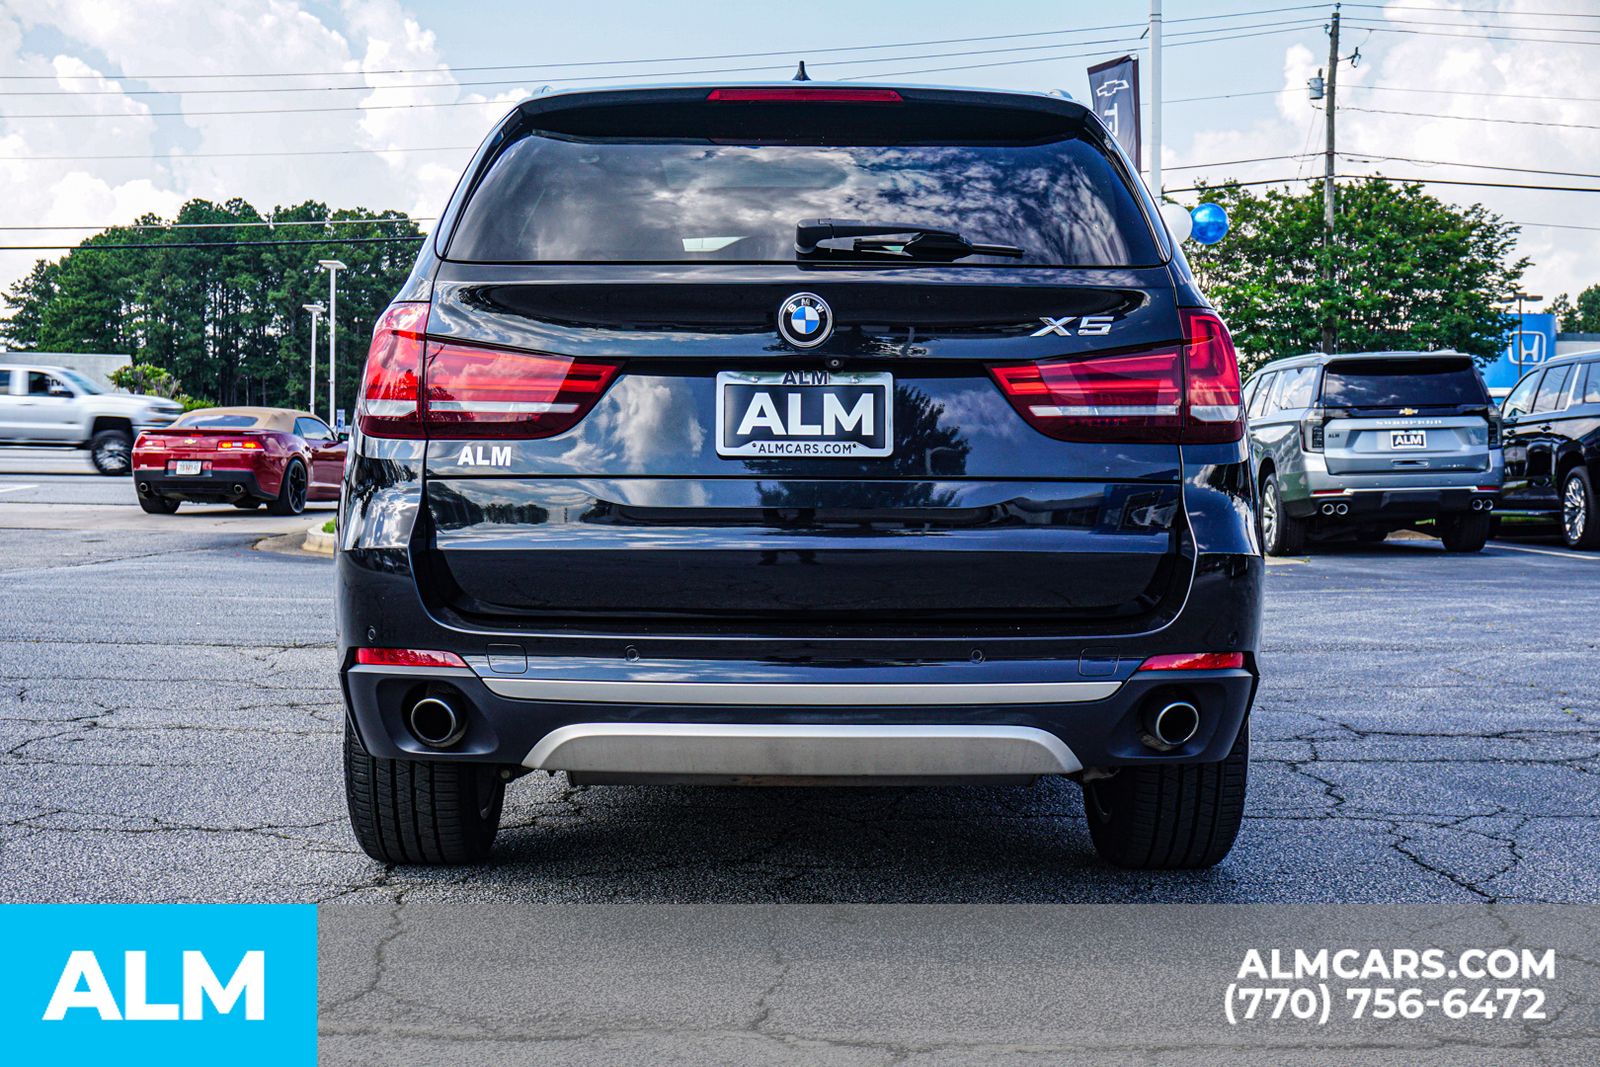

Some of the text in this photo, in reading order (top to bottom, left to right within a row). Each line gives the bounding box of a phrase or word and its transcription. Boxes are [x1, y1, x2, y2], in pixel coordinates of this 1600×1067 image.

[787, 298, 825, 314] BMW
[1030, 316, 1115, 336] X5
[782, 370, 829, 385] ALM
[736, 392, 874, 435] ALM
[1394, 435, 1422, 445] ALM
[457, 446, 512, 466] ALM
[758, 443, 852, 454] ALMCARS.COM
